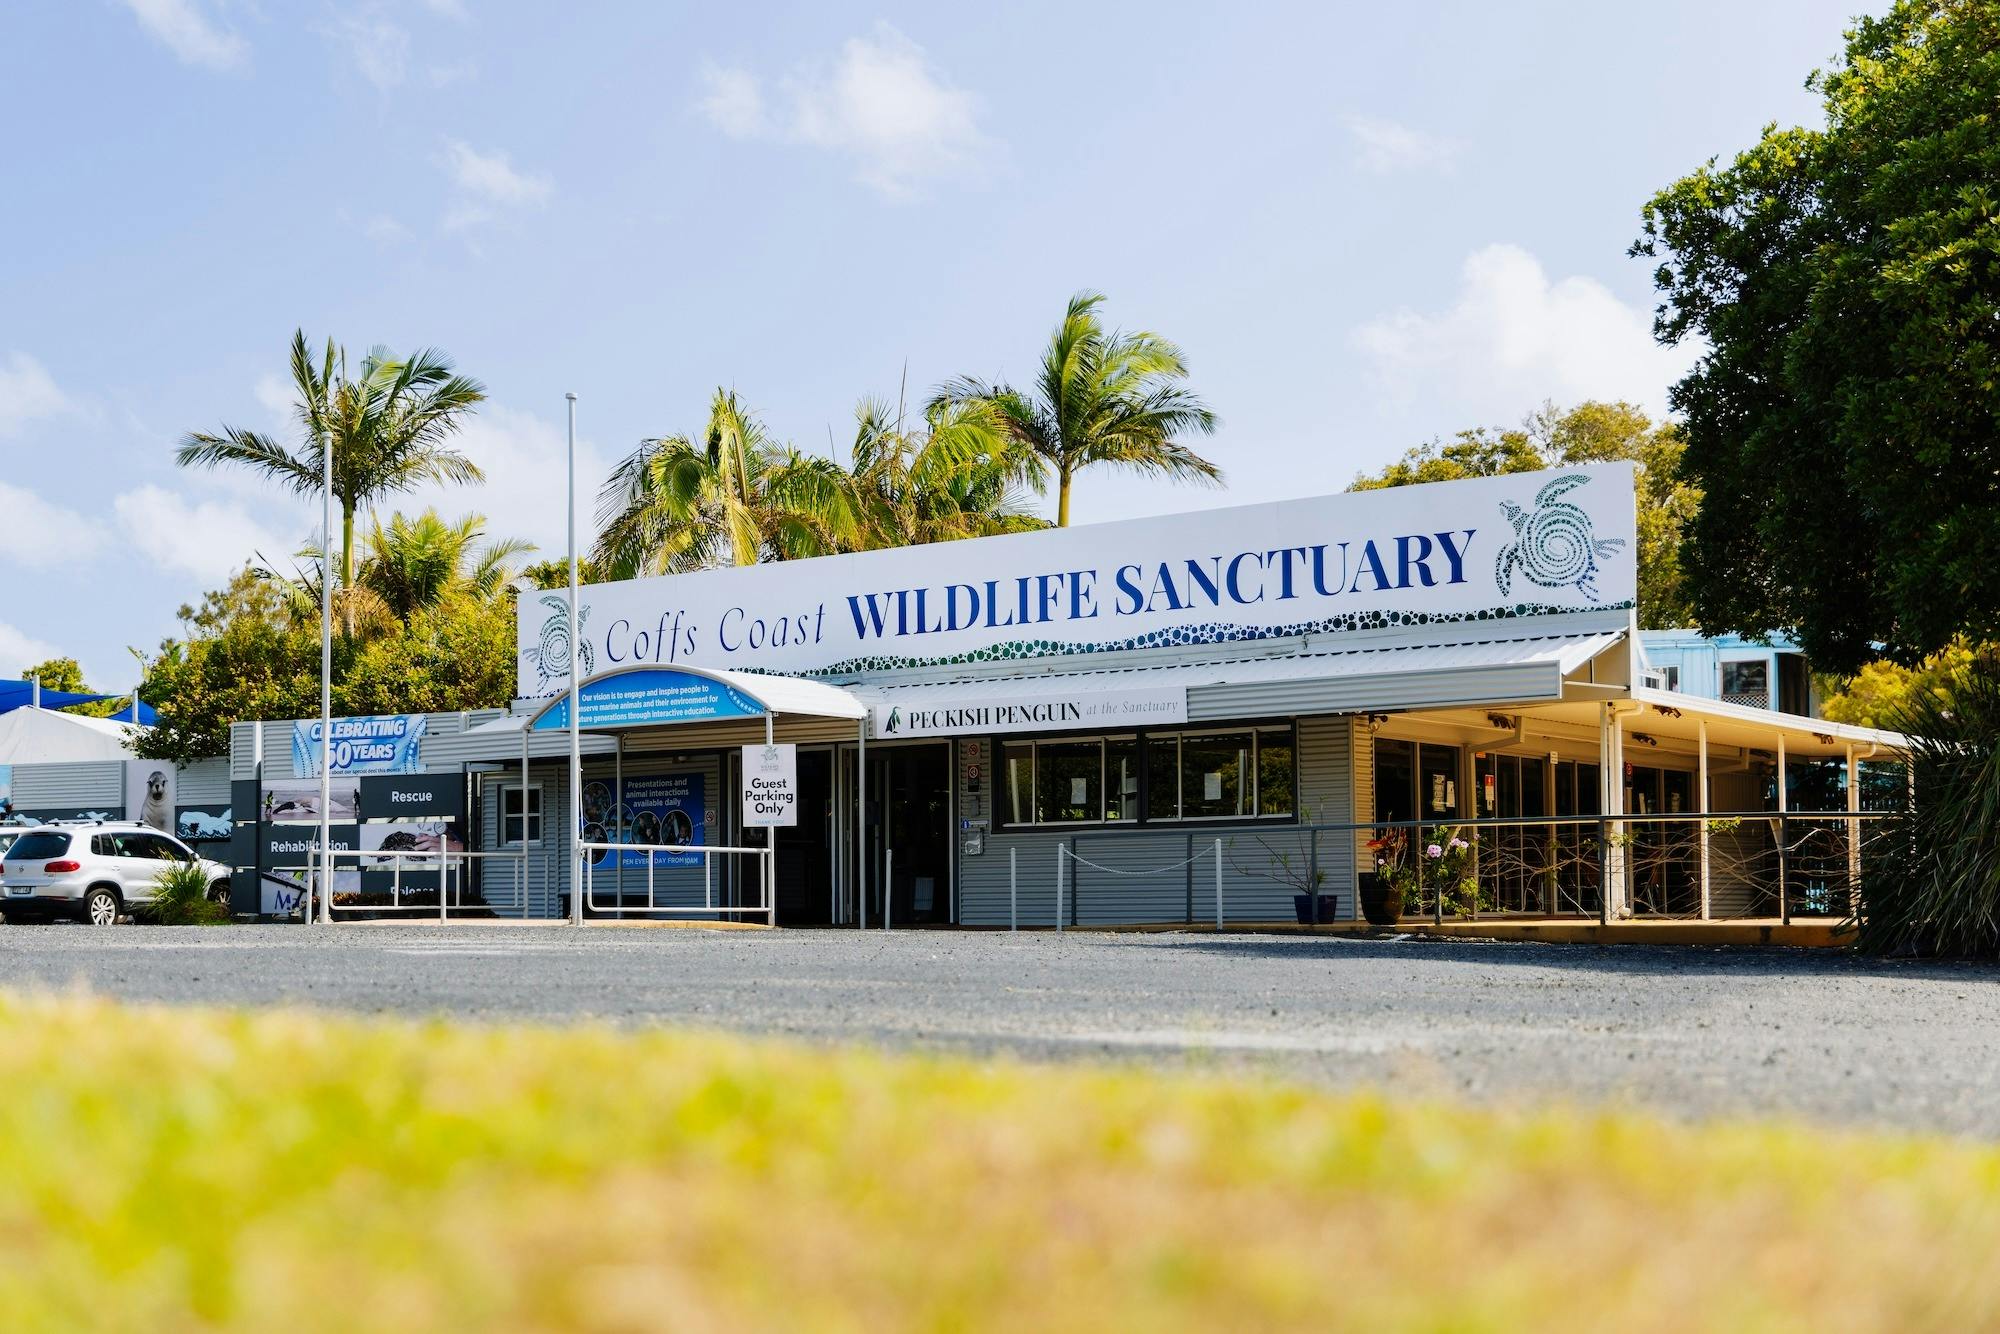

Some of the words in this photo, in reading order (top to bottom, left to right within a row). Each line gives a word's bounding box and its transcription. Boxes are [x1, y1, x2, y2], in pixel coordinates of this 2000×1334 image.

[606, 610, 697, 664] Coffs
[719, 602, 826, 652] Coast
[846, 569, 1098, 640] WILDLIFE
[1115, 529, 1477, 616] SANCTUARY
[582, 693, 593, 702] Our
[594, 691, 610, 701] vision
[611, 692, 616, 700] is
[617, 691, 623, 699] to
[624, 690, 645, 699] engage
[647, 688, 658, 697] and
[659, 687, 679, 697] inspire
[680, 685, 700, 695] people
[702, 684, 709, 692] to
[578, 704, 599, 713] nserve
[599, 702, 620, 711] marine
[620, 700, 642, 710] animals
[643, 699, 654, 708] and
[655, 698, 669, 707] their
[670, 695, 708, 705] environment
[709, 694, 718, 703] for
[594, 712, 627, 723] generations
[628, 710, 651, 720] through
[652, 707, 683, 718] interactive
[684, 706, 716, 716] education.
[909, 706, 989, 729] PECKISH
[995, 702, 1080, 724] PENGUIN
[1086, 703, 1097, 716] at
[1101, 701, 1117, 715] the
[1121, 699, 1178, 714] Sanctuary
[310, 719, 407, 741] CLEBRATING
[352, 743, 395, 761] YEARS
[628, 779, 672, 789] Presentations
[674, 778, 687, 786] and
[752, 778, 787, 789] Guest
[391, 790, 433, 803] Rescue
[626, 789, 648, 798] animal
[649, 787, 689, 797] interactions
[745, 790, 793, 804] Parking
[633, 798, 663, 807] available
[665, 797, 682, 807] daily
[755, 802, 784, 816] Only
[271, 840, 349, 853] Rehabiltion
[667, 856, 684, 864] FROM
